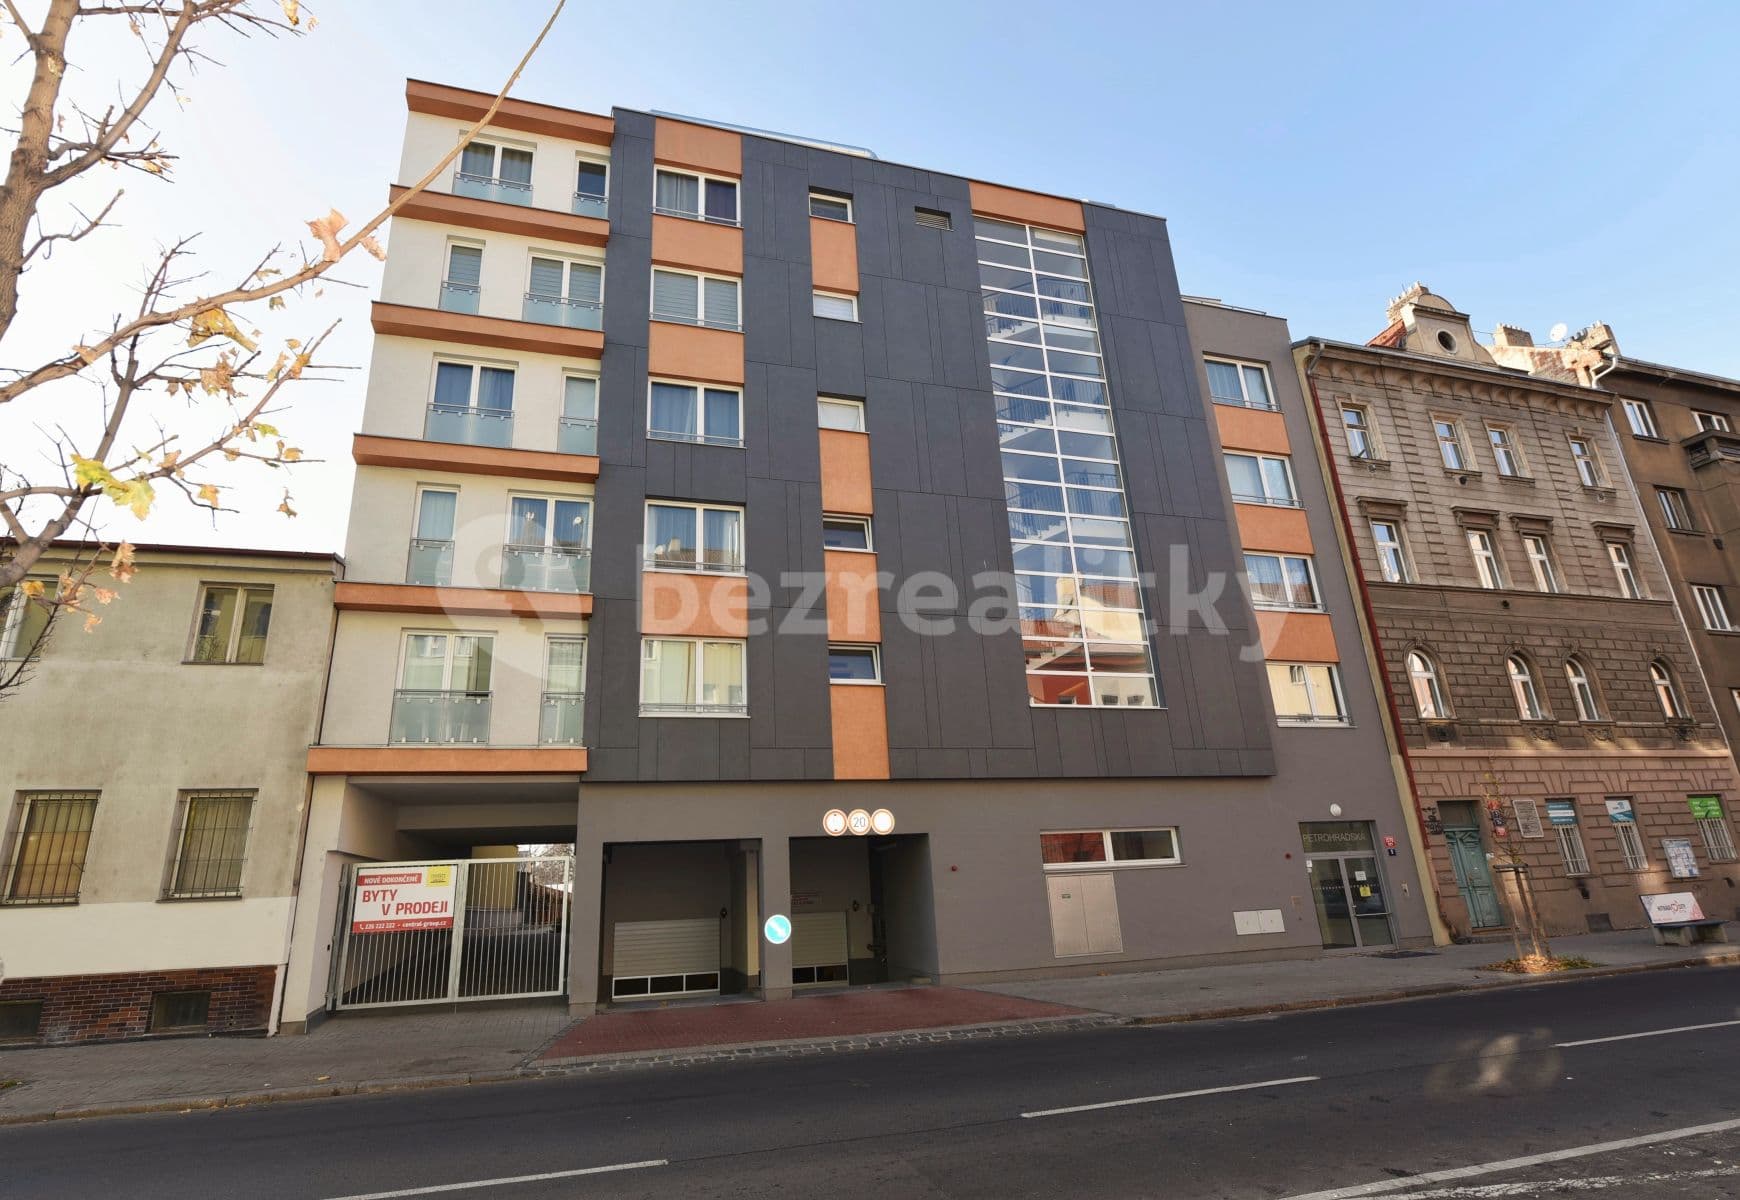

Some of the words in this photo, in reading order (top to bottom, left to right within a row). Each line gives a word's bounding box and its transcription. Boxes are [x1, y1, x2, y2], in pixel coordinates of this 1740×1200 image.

[853, 816, 866, 828] 20
[362, 889, 398, 903] BYTY
[382, 903, 391, 916] V
[395, 901, 448, 915] PRODEJI
